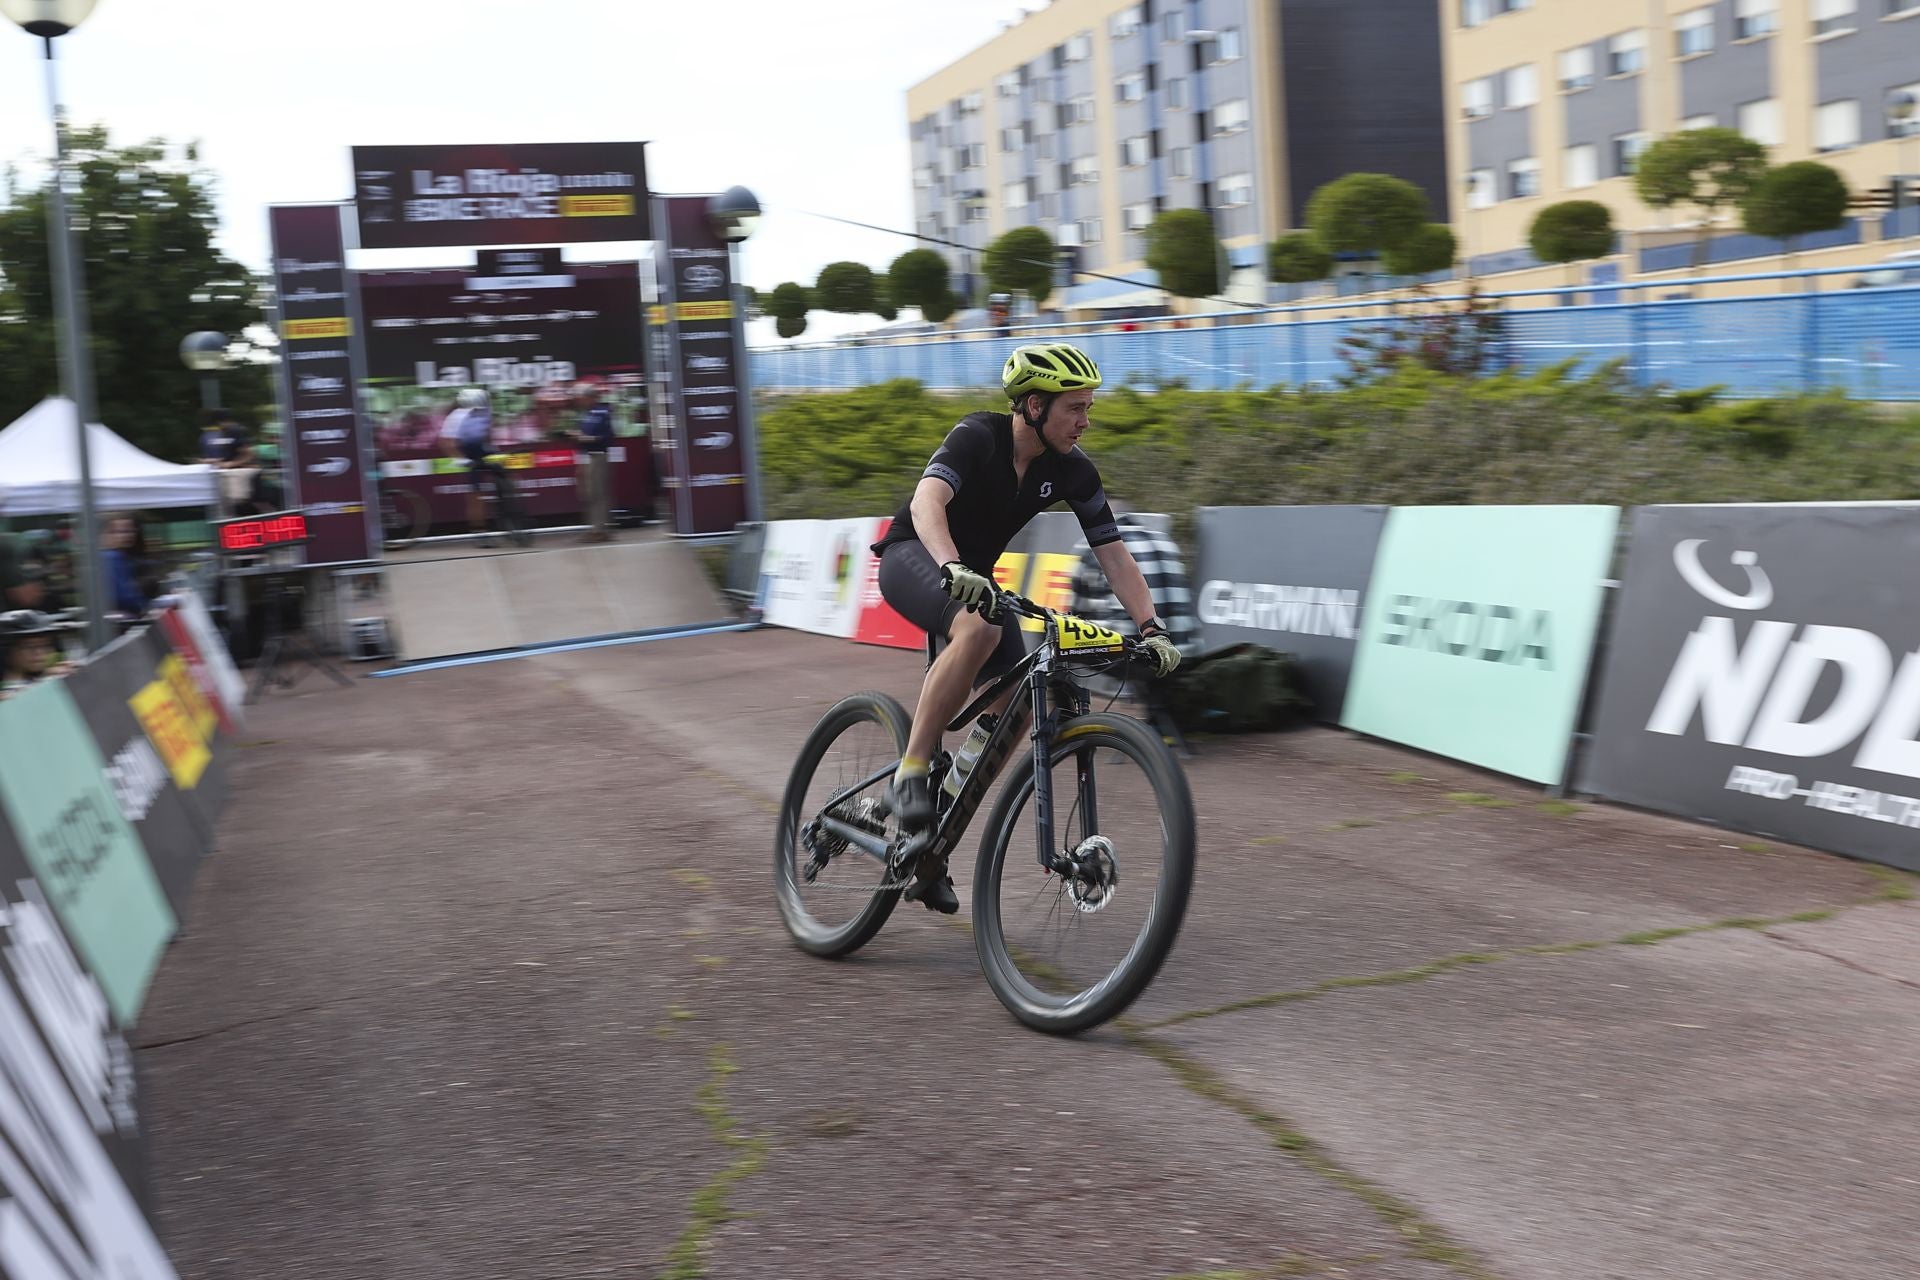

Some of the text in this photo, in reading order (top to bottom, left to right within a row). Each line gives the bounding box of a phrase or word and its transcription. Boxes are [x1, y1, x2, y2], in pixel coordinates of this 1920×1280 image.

[411, 169, 466, 195] La
[463, 168, 561, 197] Rioja
[416, 361, 471, 387] La
[1026, 369, 1060, 381] SCOTT
[1198, 579, 1360, 639] GARMIN
